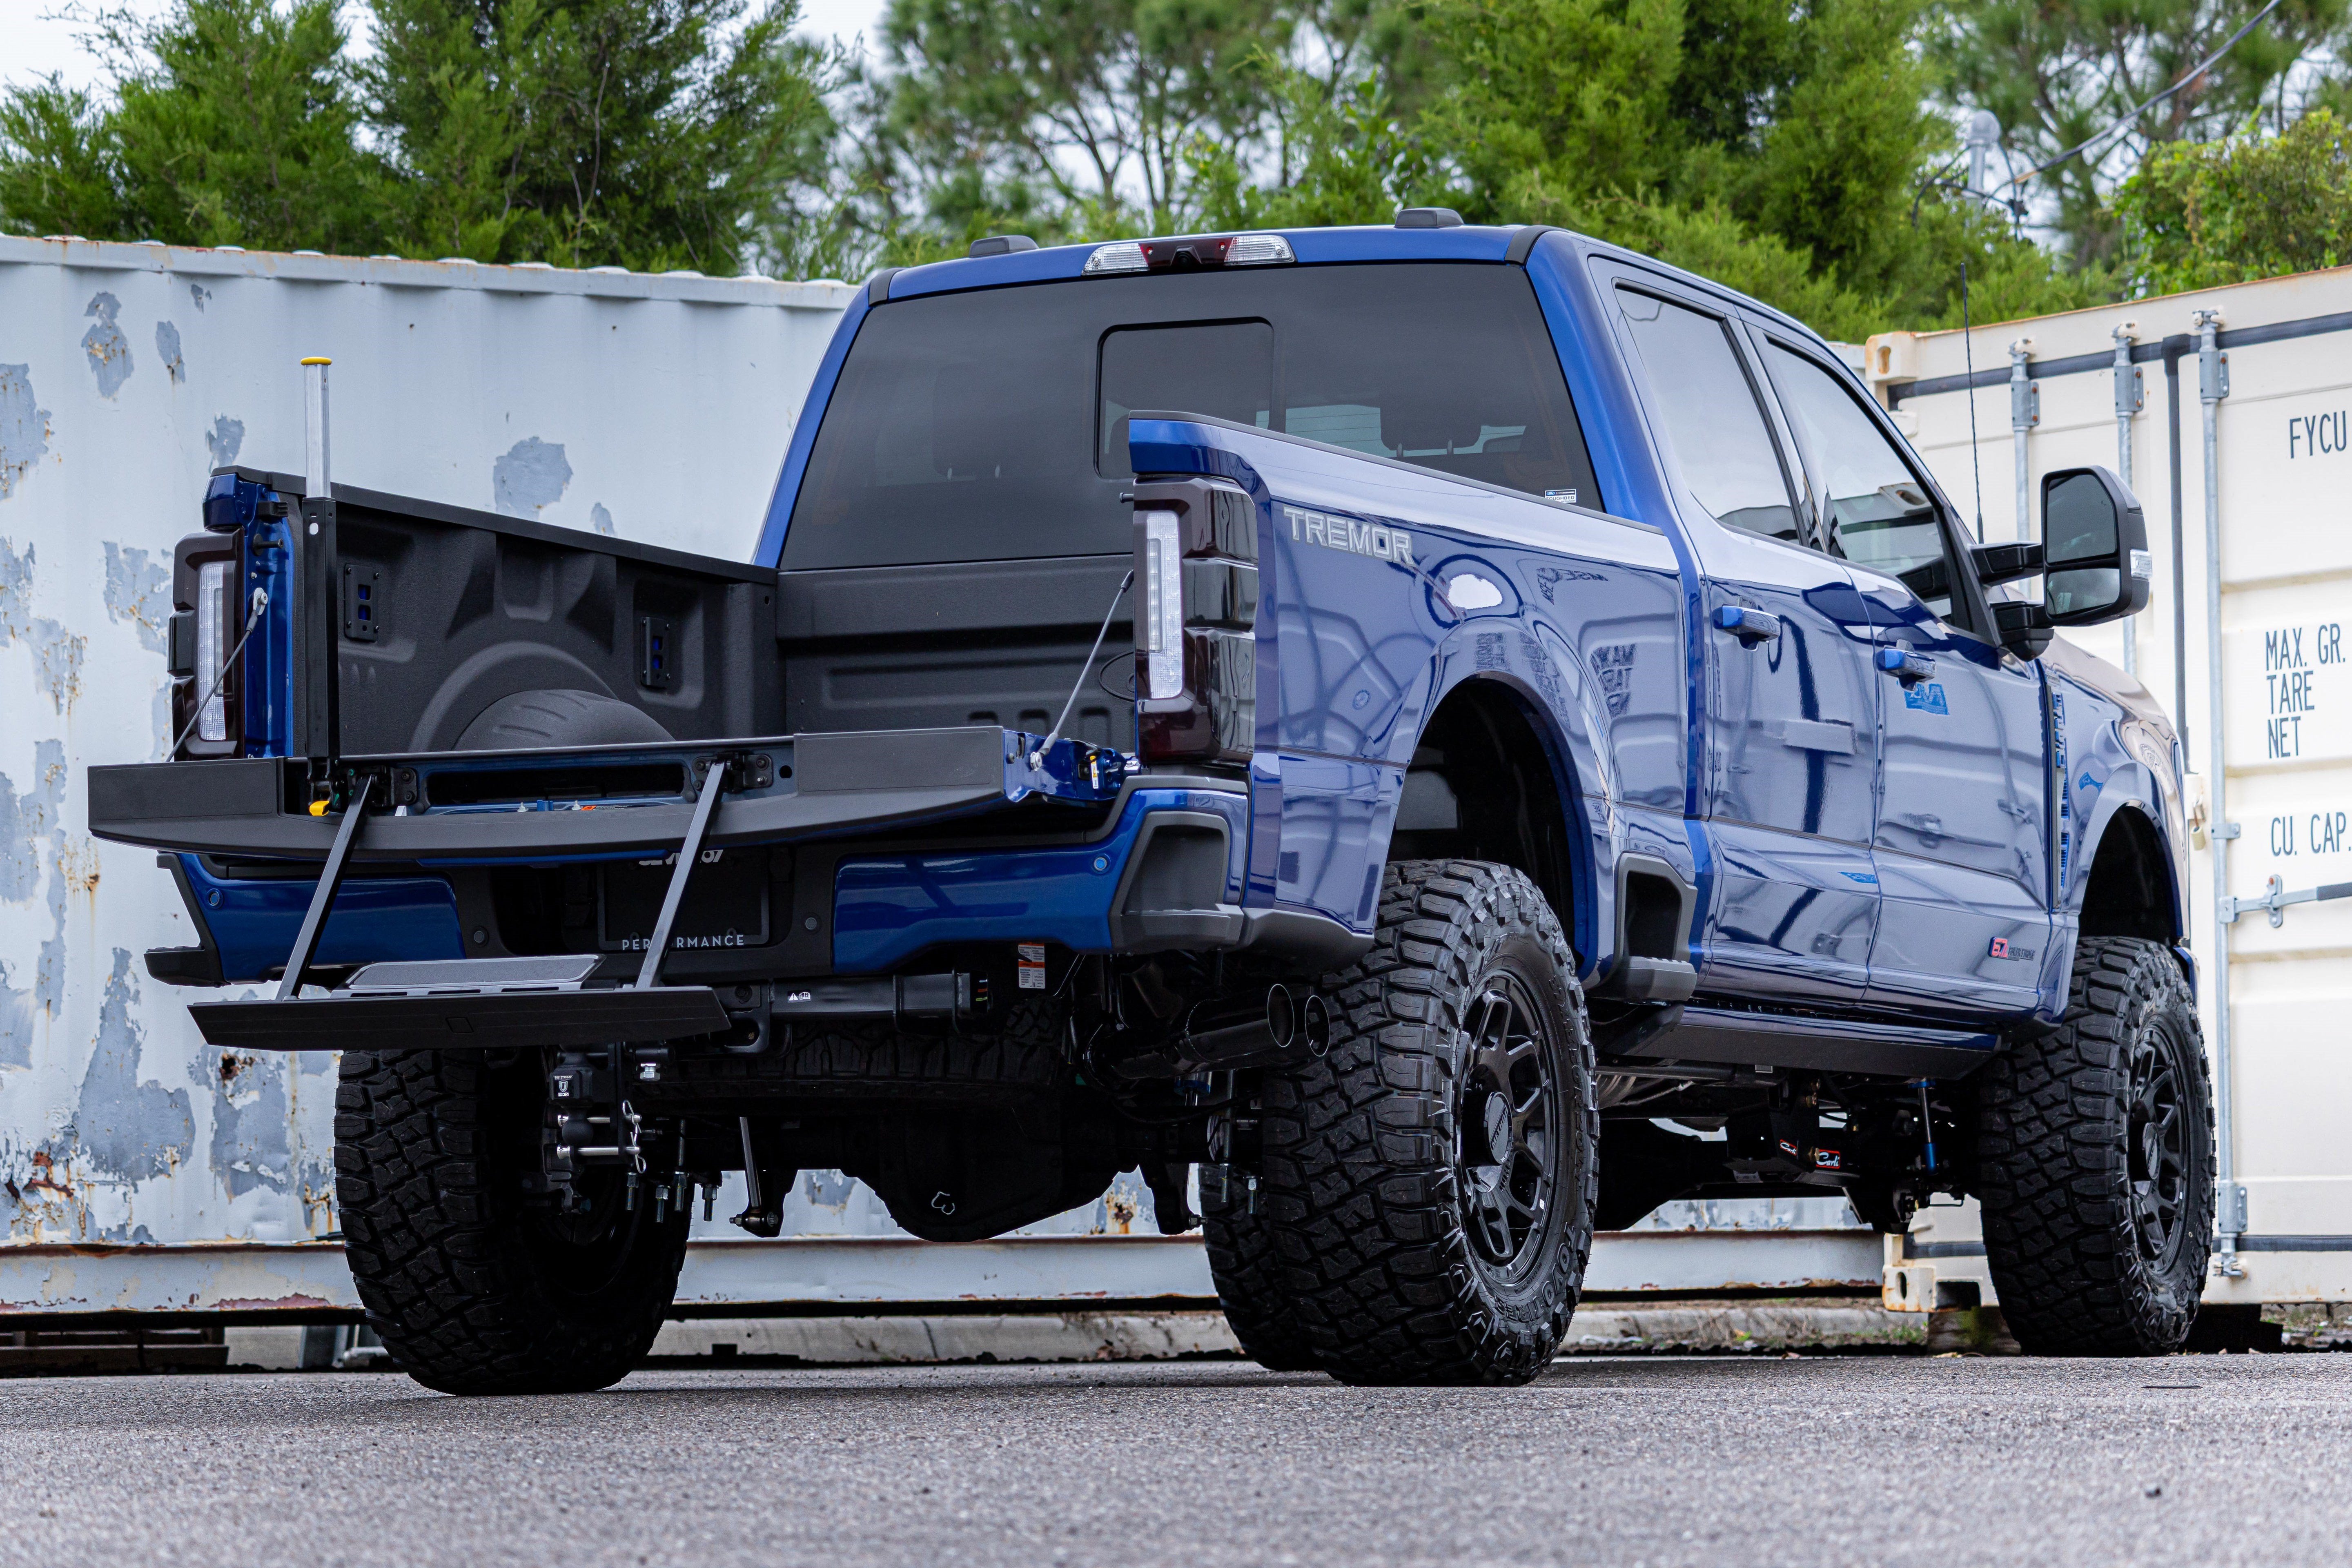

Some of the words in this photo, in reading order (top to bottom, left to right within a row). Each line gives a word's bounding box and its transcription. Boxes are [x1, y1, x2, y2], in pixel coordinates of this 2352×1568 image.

[2290, 410, 2347, 459] FYCU
[1283, 504, 1416, 567] TREMOR
[2266, 628, 2307, 671] MAX.
[2318, 623, 2345, 664] GR.
[2266, 670, 2315, 714] TARE
[2267, 716, 2301, 759] NET
[2271, 816, 2297, 857] CU.
[2310, 812, 2351, 854] CAP.
[622, 935, 744, 951] PERRMANCE
[1542, 1222, 1576, 1307] TOYO
